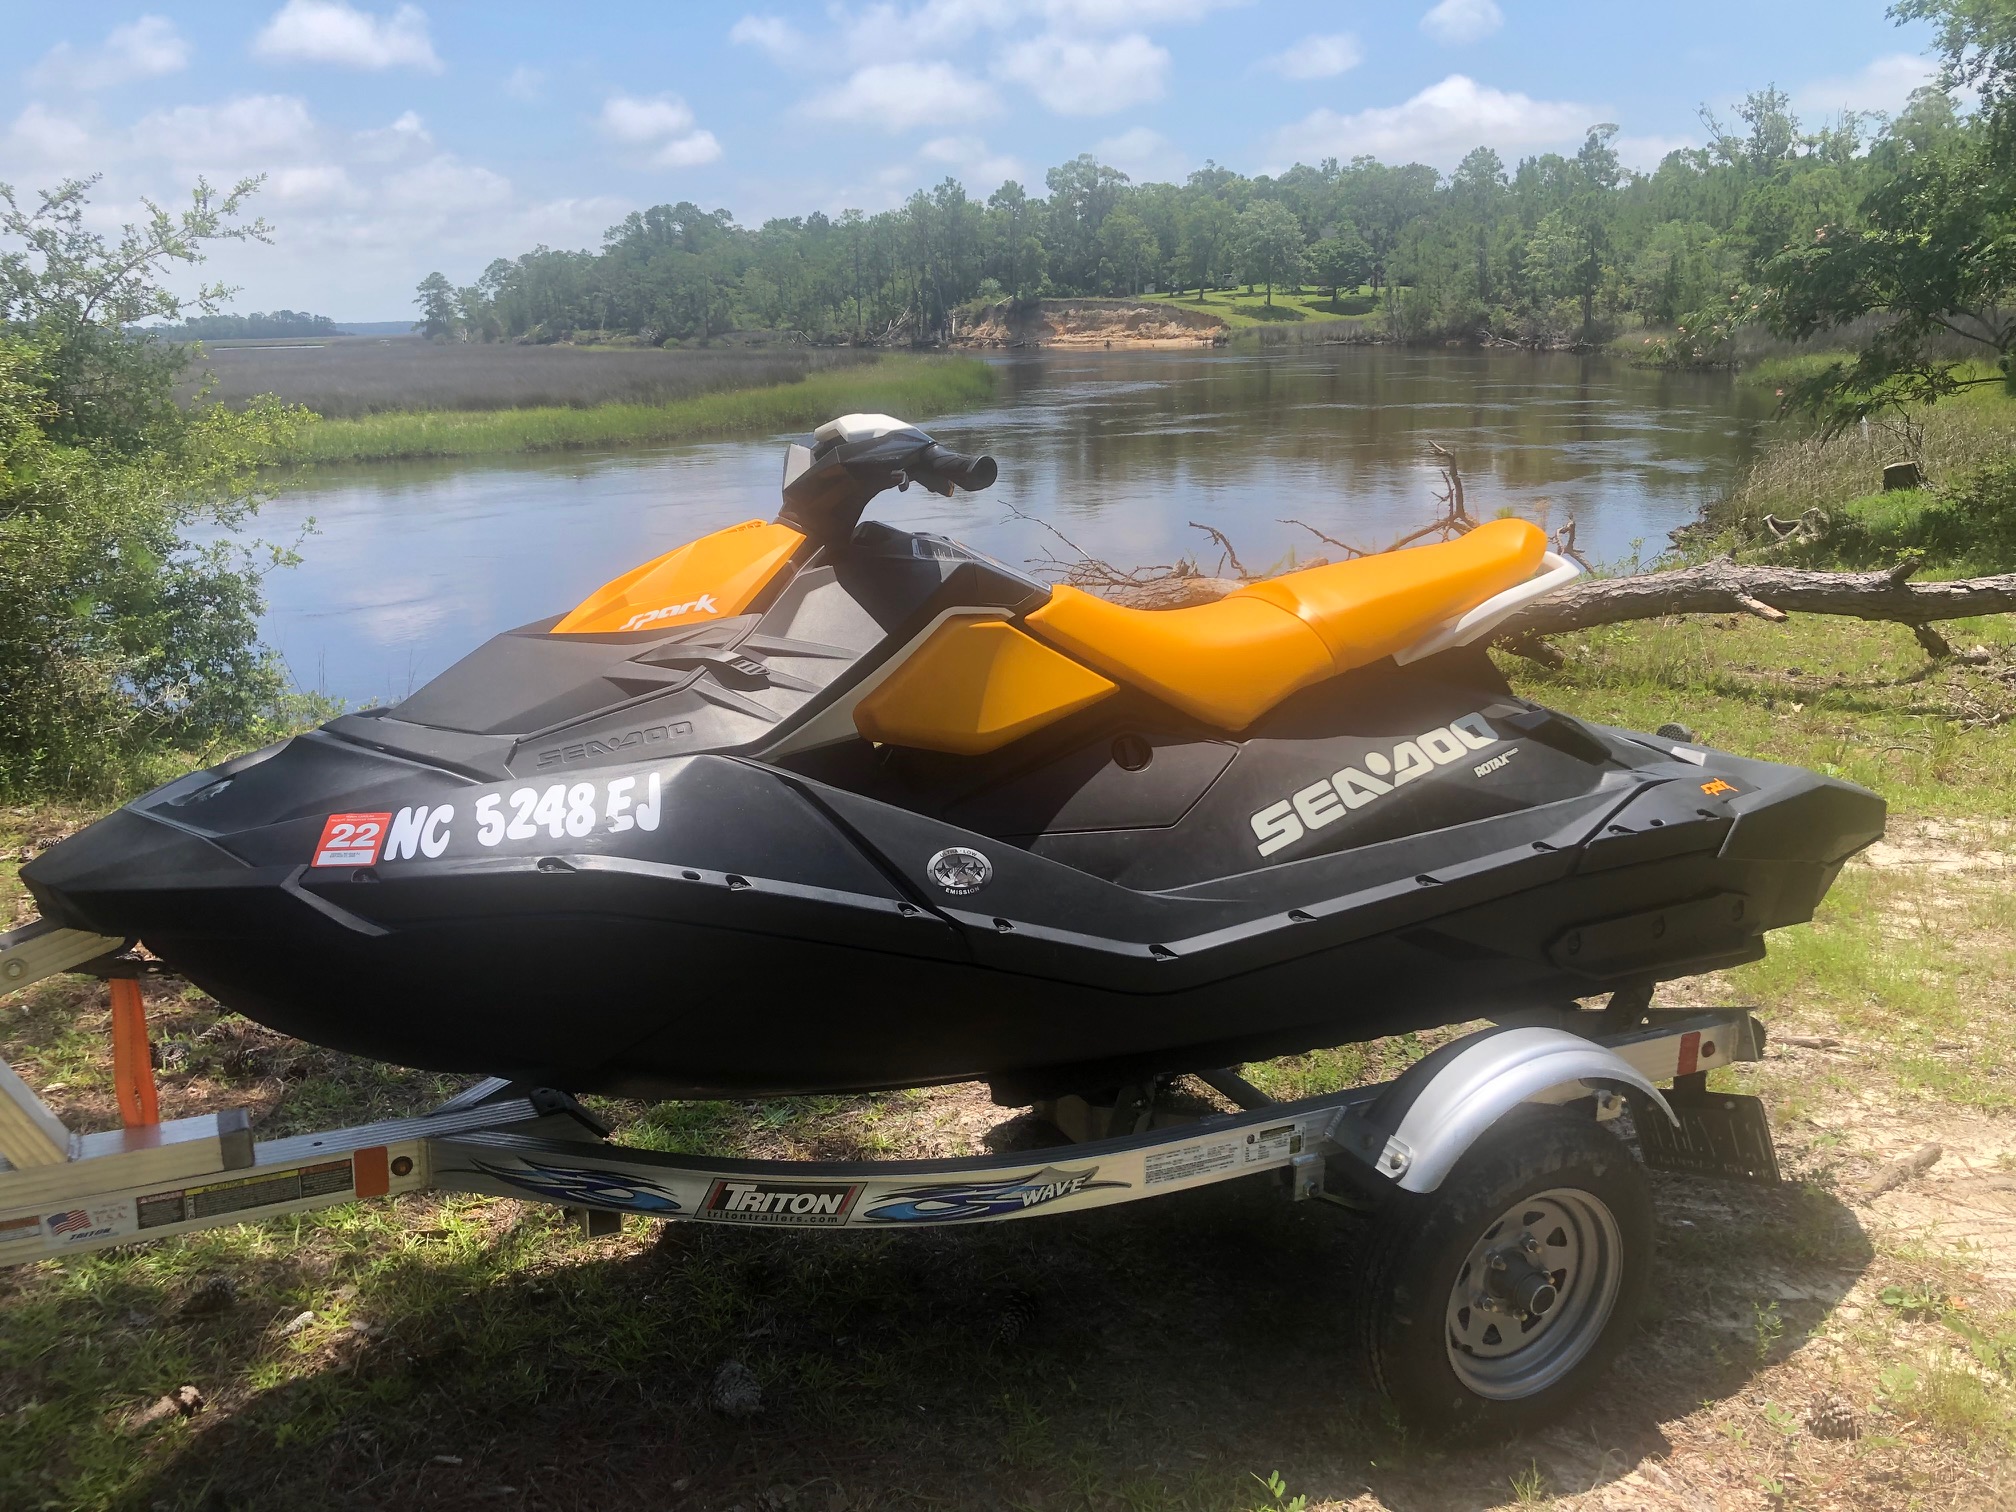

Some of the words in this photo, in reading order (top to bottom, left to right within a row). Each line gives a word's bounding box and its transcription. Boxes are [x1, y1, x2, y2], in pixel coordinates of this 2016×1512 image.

[1473, 753, 1510, 778] ROTAX
[383, 804, 455, 862] NC
[475, 783, 597, 847] 5248
[606, 772, 661, 833] EJ
[326, 822, 380, 848] 22
[945, 886, 980, 896] EMISSION
[1021, 1177, 1086, 1207] WAVE
[707, 1210, 838, 1223] tritontrailers.com
